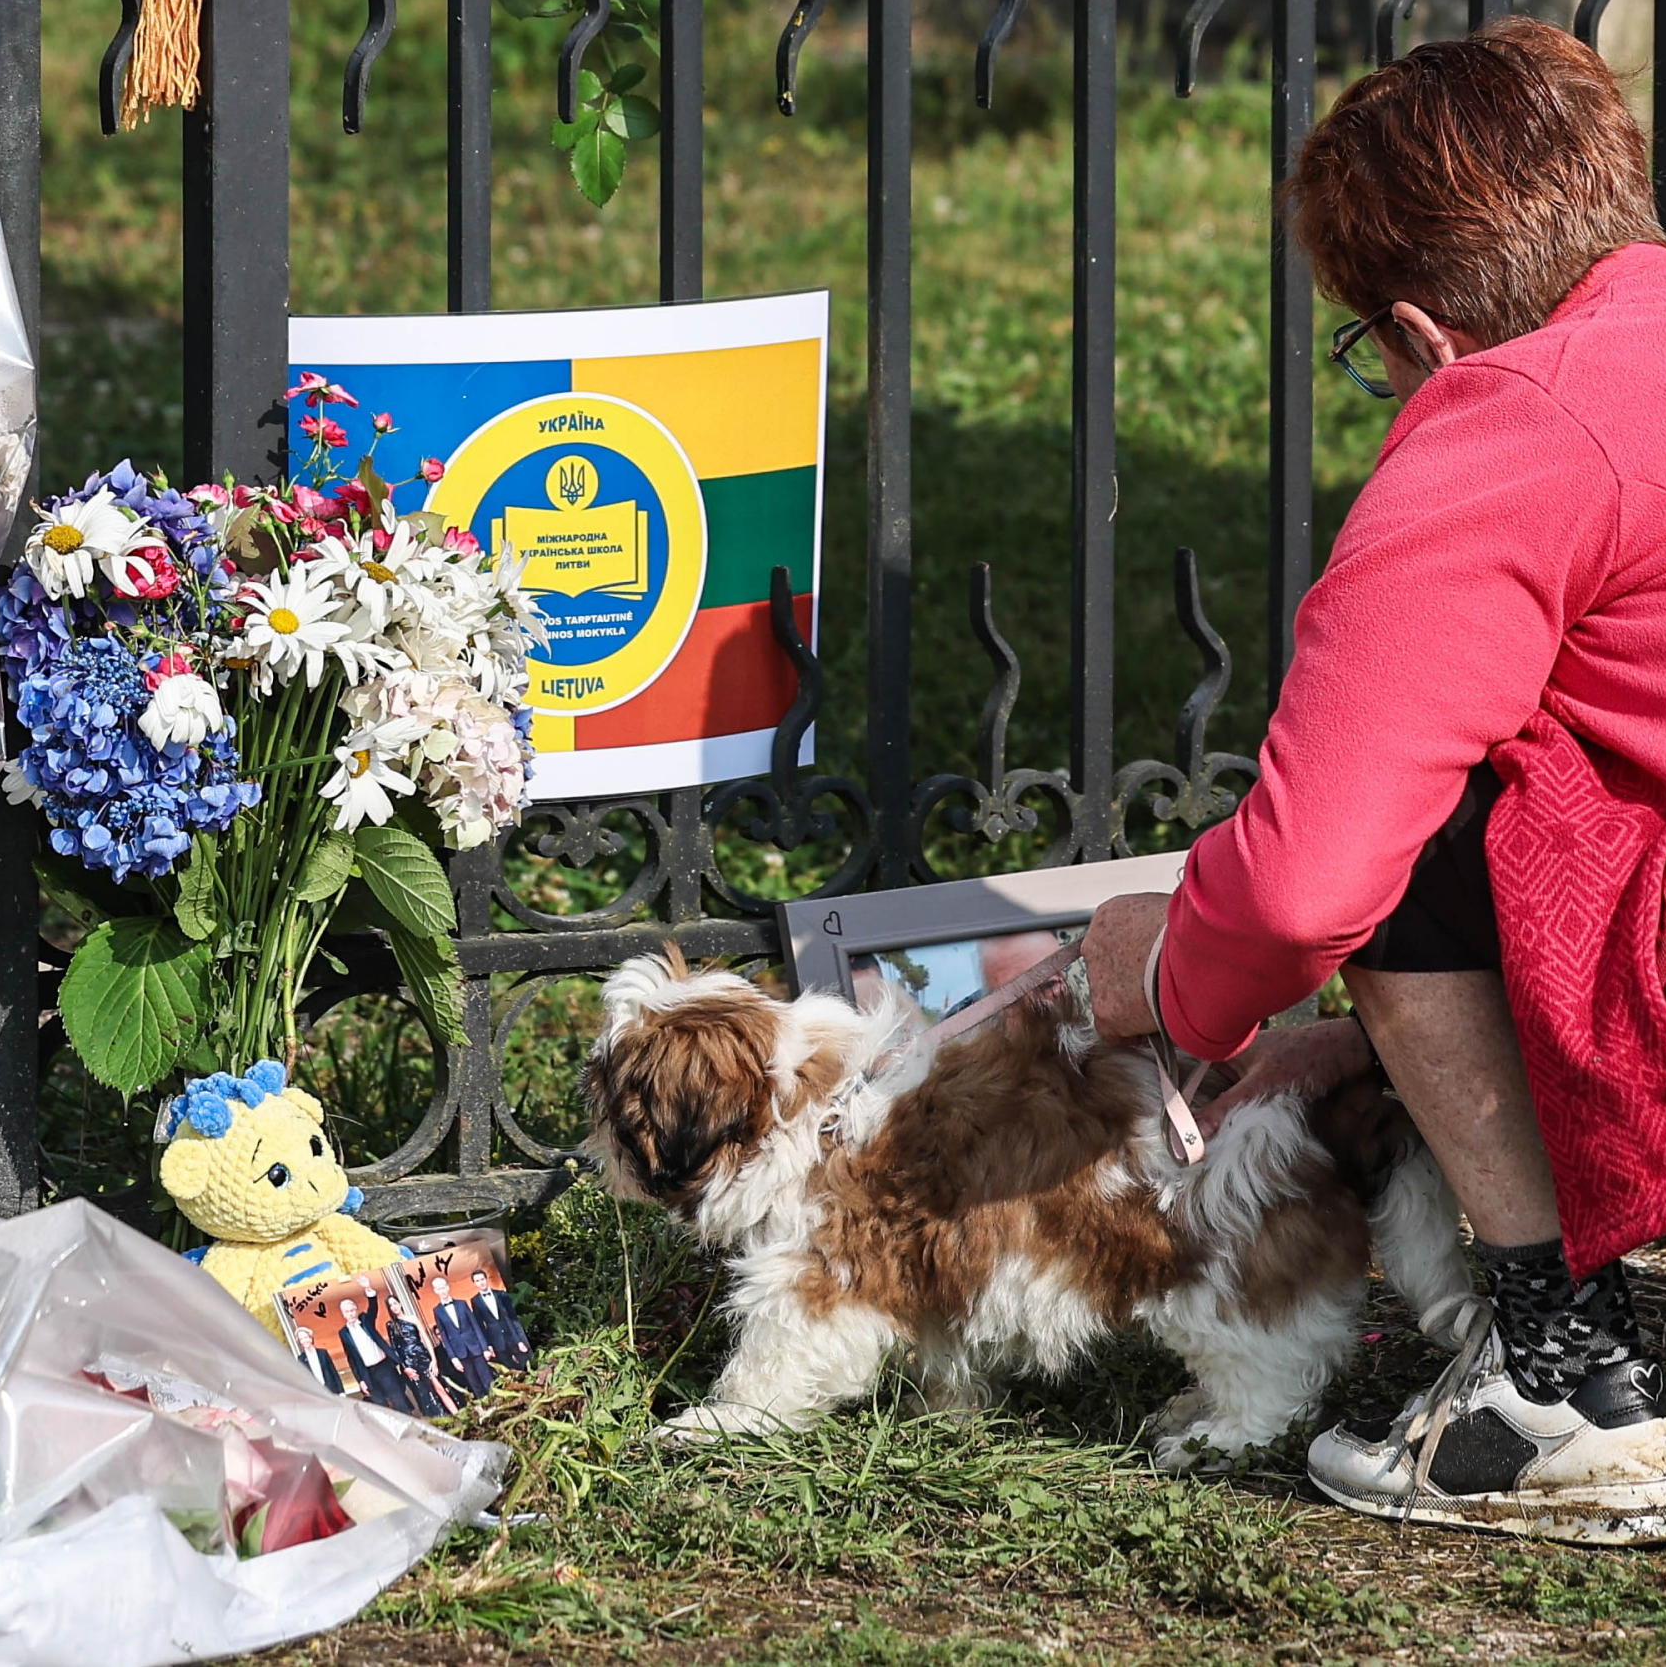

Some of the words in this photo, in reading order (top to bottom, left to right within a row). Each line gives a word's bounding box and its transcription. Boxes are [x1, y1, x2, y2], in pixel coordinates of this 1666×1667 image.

[538, 410, 605, 433] УКРАЇНА
[536, 533, 608, 544] МІЖНАРОДНА
[587, 544, 623, 554] ШКОЛА
[555, 560, 590, 570] ЛИТВИ
[565, 610, 633, 625] TARPTAUTINĖ
[547, 629, 573, 639] INOS
[576, 626, 626, 638] MOKYKLA
[541, 676, 605, 700] LIETUVA
